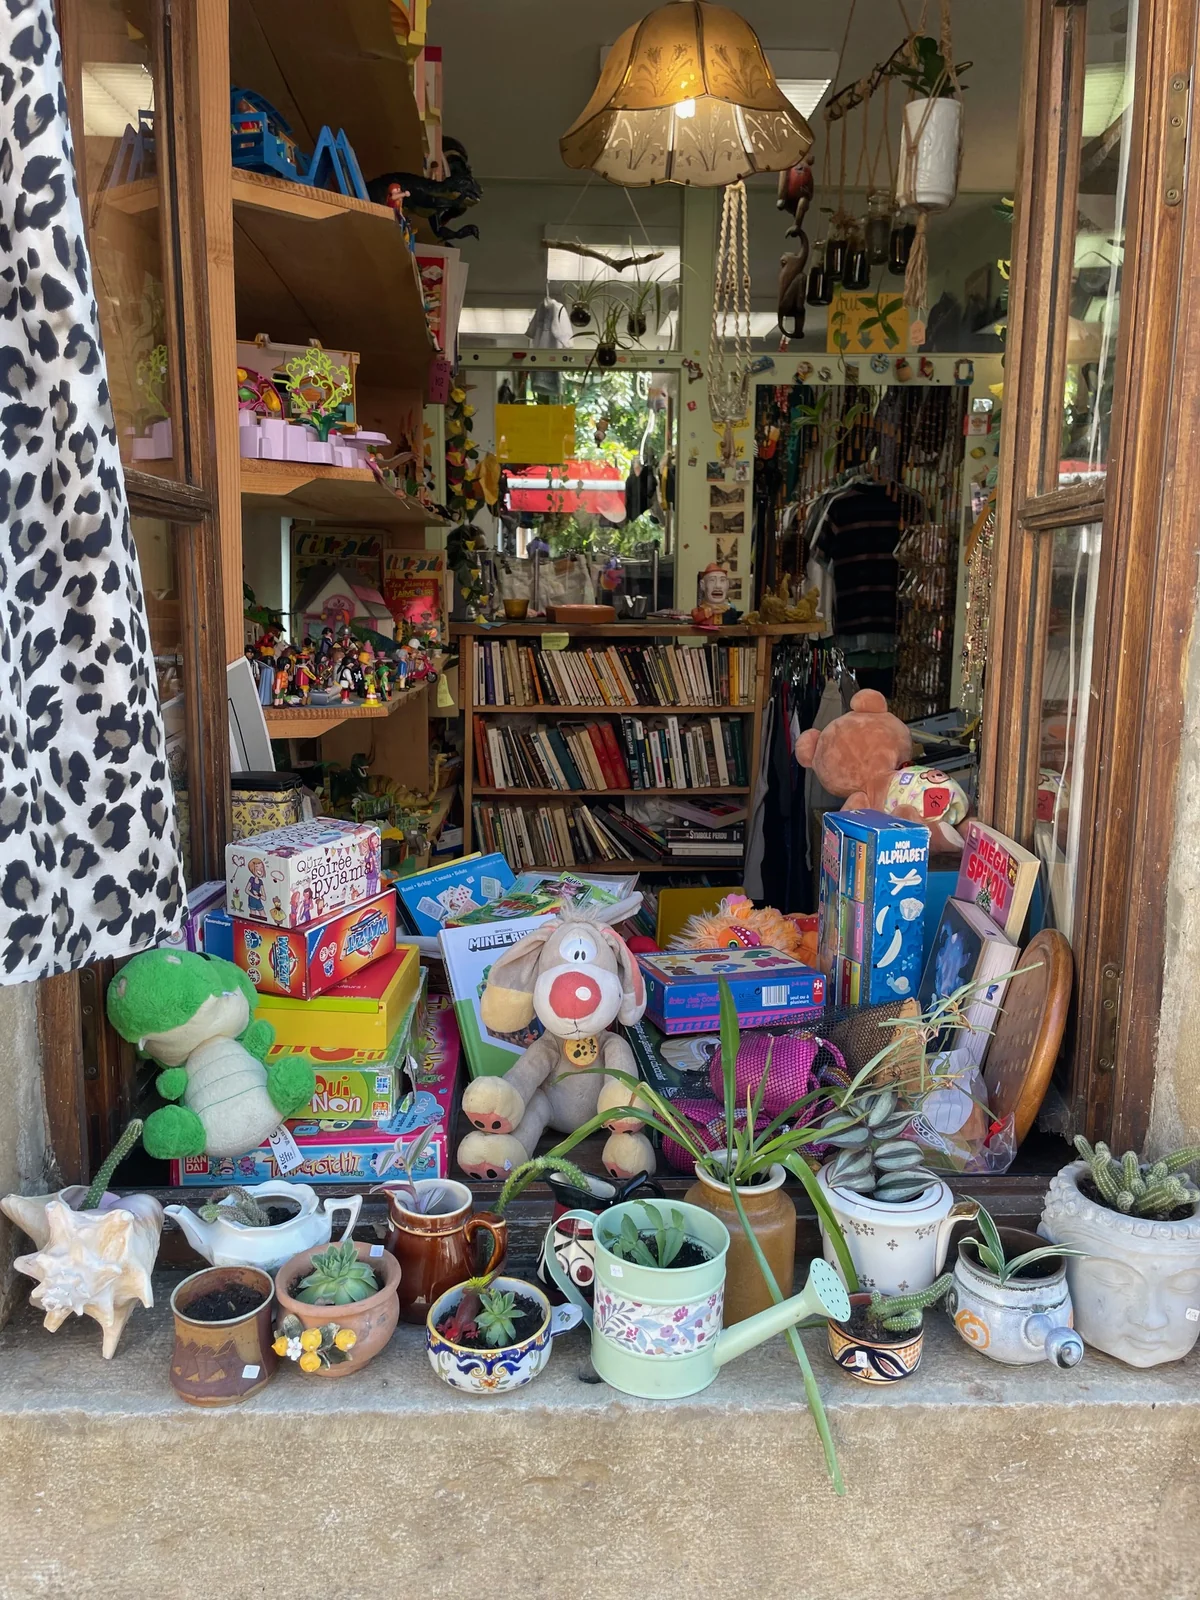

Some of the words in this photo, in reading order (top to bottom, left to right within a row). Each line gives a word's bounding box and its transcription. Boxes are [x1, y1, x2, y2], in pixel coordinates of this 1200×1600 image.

[877, 848, 927, 865] ALPHABET
[311, 856, 352, 881] soirée
[312, 862, 373, 899] pyjama
[312, 1092, 361, 1113] Non
[186, 1163, 203, 1172] DAI
